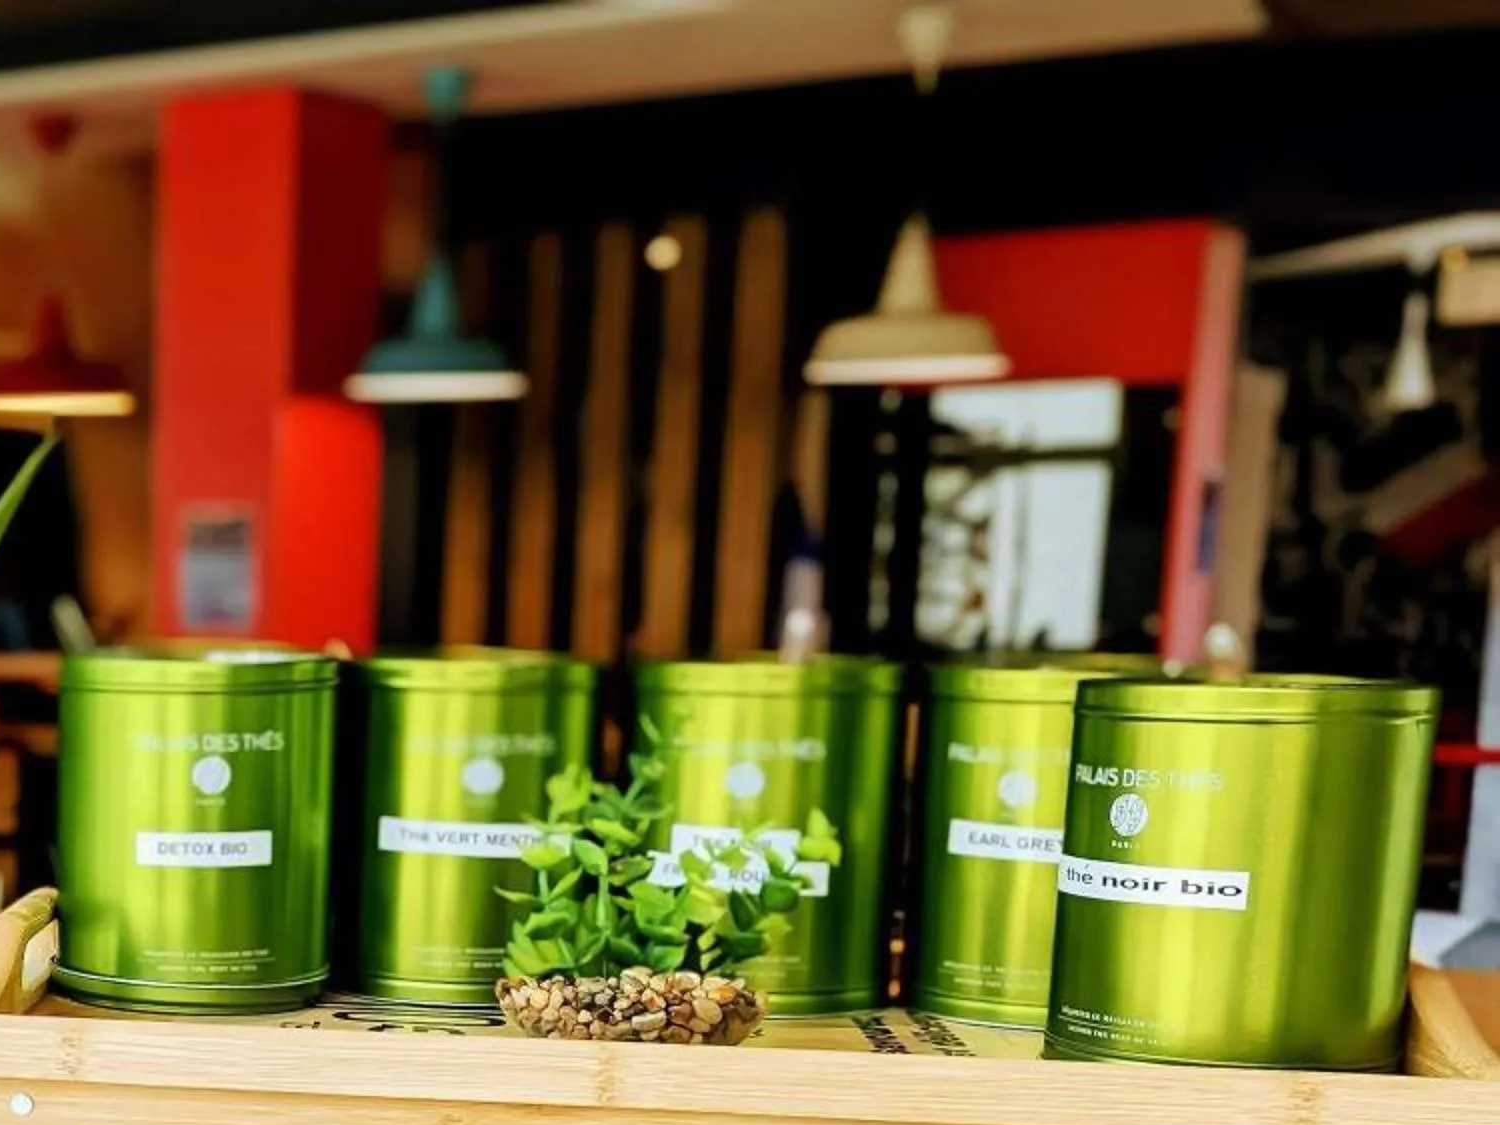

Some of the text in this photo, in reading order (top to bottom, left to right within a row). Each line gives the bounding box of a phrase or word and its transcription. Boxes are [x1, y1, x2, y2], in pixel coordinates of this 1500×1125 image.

[1122, 768, 1161, 790] DES
[157, 841, 249, 856] DETOX BIO
[435, 831, 480, 846] VERT
[486, 832, 550, 848] MENTH
[967, 831, 1011, 849] EARL
[1065, 863, 1244, 898] thé noir bio
